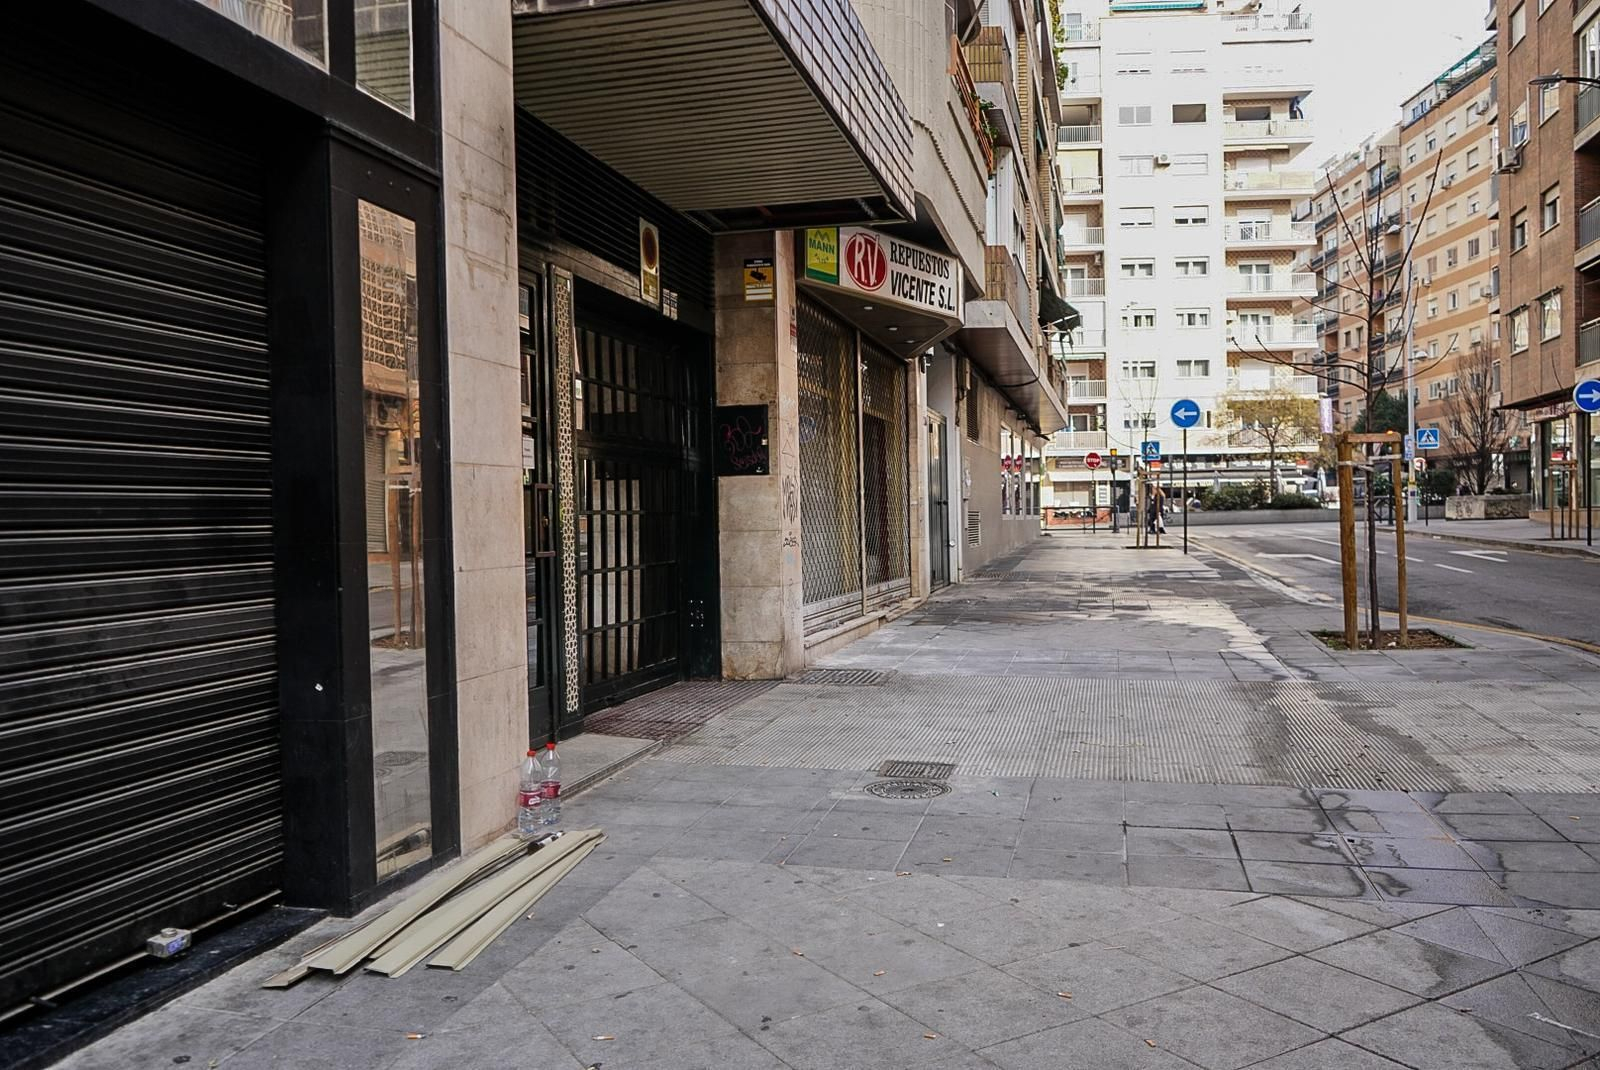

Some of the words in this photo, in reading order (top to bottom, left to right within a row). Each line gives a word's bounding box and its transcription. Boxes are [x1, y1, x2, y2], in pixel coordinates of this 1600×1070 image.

[809, 237, 835, 255] MANN
[890, 241, 949, 280] REPUESTOS
[891, 270, 936, 306] VICENTE
[938, 284, 955, 311] S.L.
